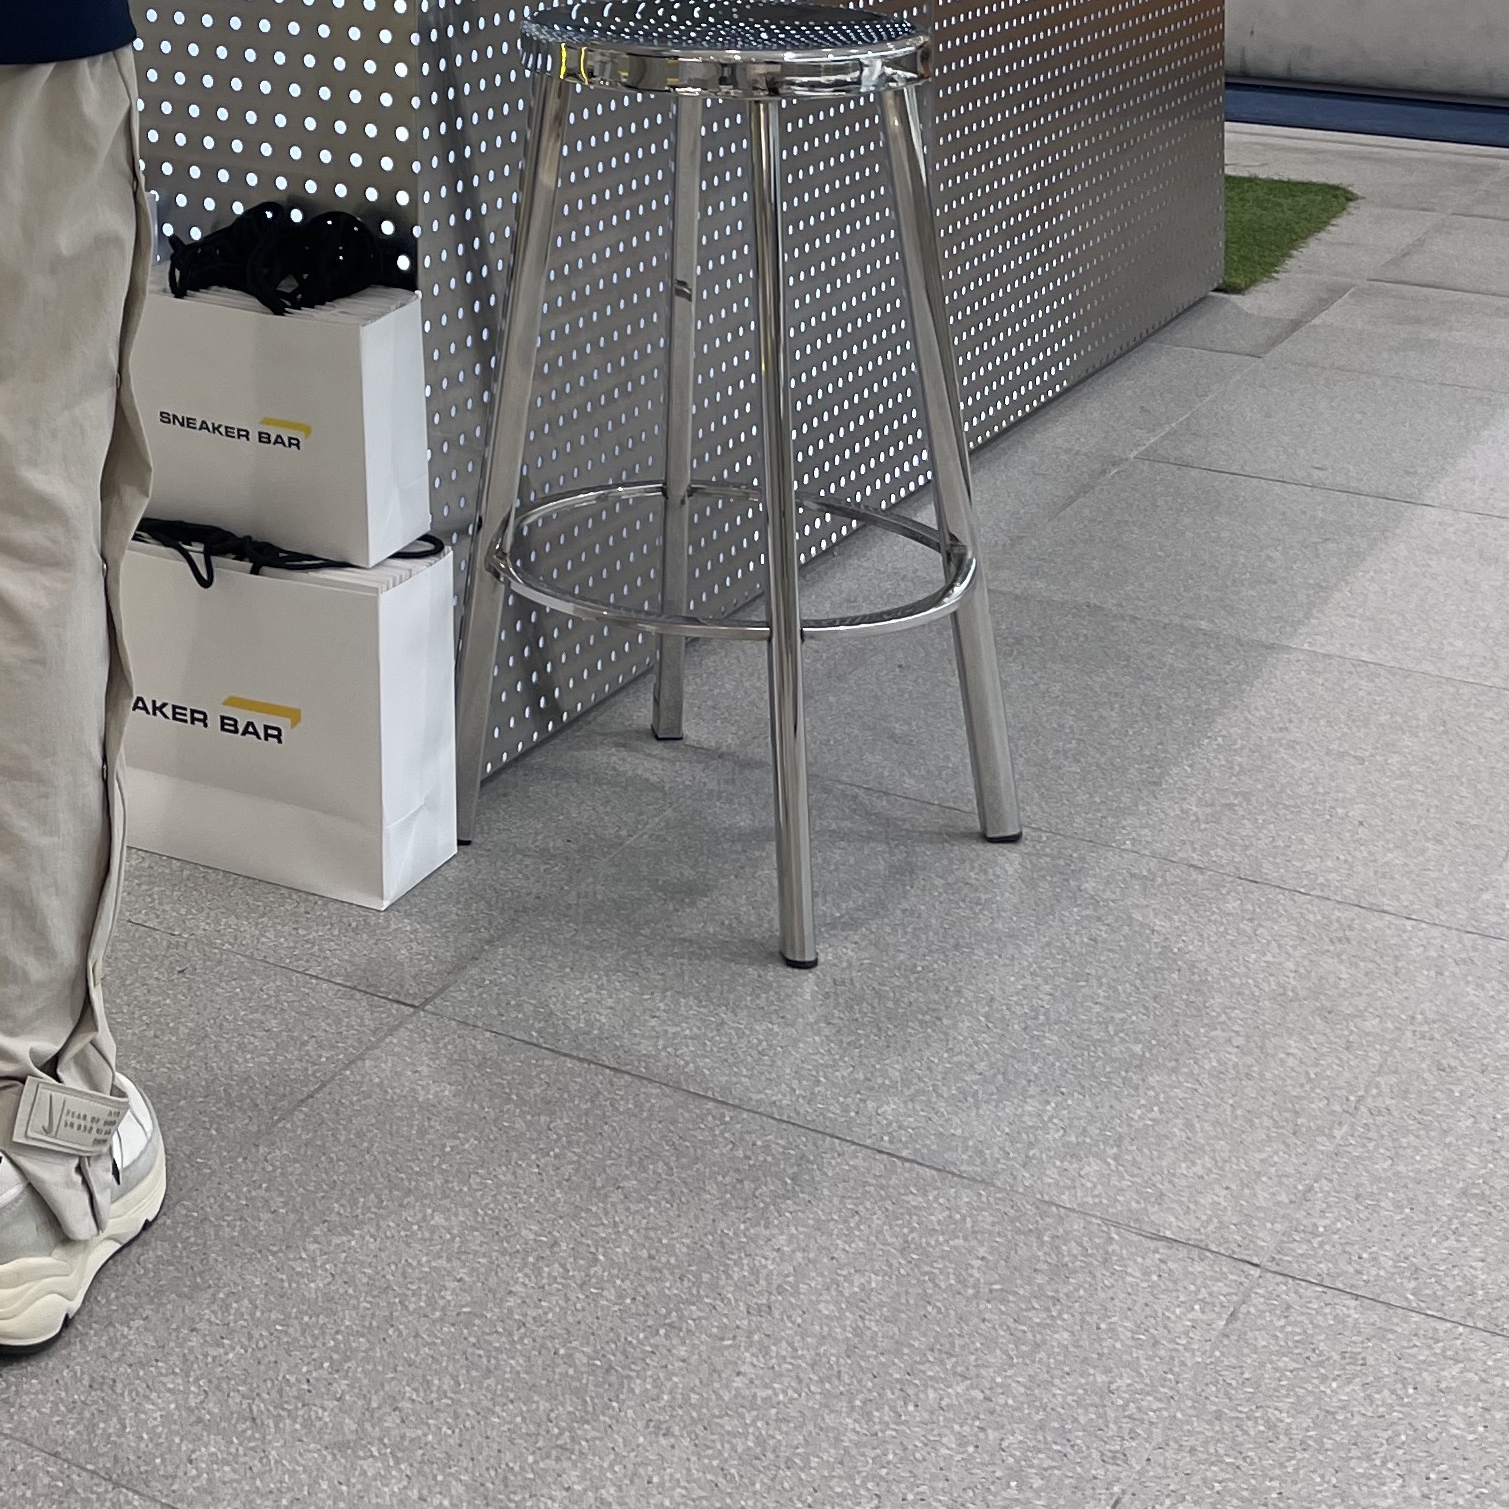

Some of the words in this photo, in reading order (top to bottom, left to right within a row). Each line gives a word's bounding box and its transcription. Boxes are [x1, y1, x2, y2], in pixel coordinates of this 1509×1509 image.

[159, 411, 250, 441] SNEAKER
[258, 431, 301, 450] BAR
[219, 714, 283, 745] BAR
